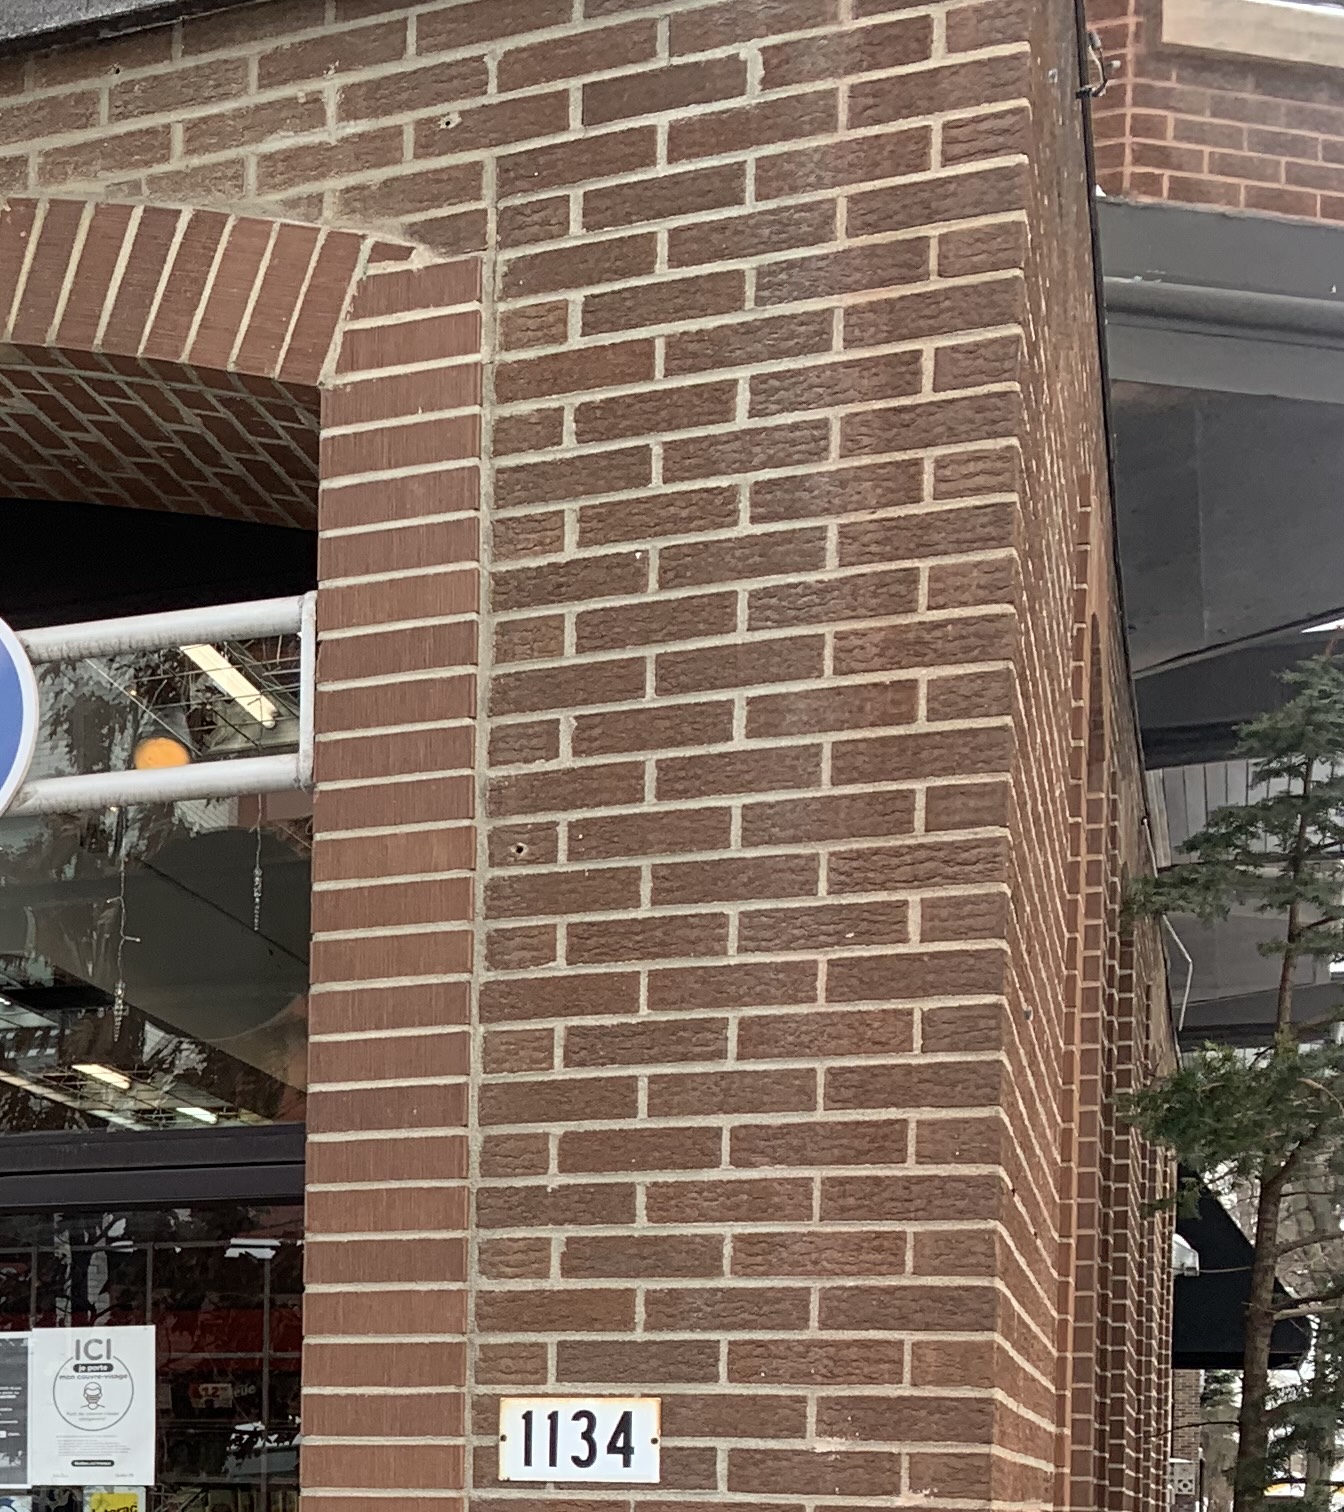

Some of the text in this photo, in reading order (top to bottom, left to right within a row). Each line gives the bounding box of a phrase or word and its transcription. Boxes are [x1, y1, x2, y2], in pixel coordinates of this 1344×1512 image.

[75, 1338, 111, 1360] ICI
[78, 1364, 108, 1373] je porte
[521, 1409, 635, 1468] 1134
